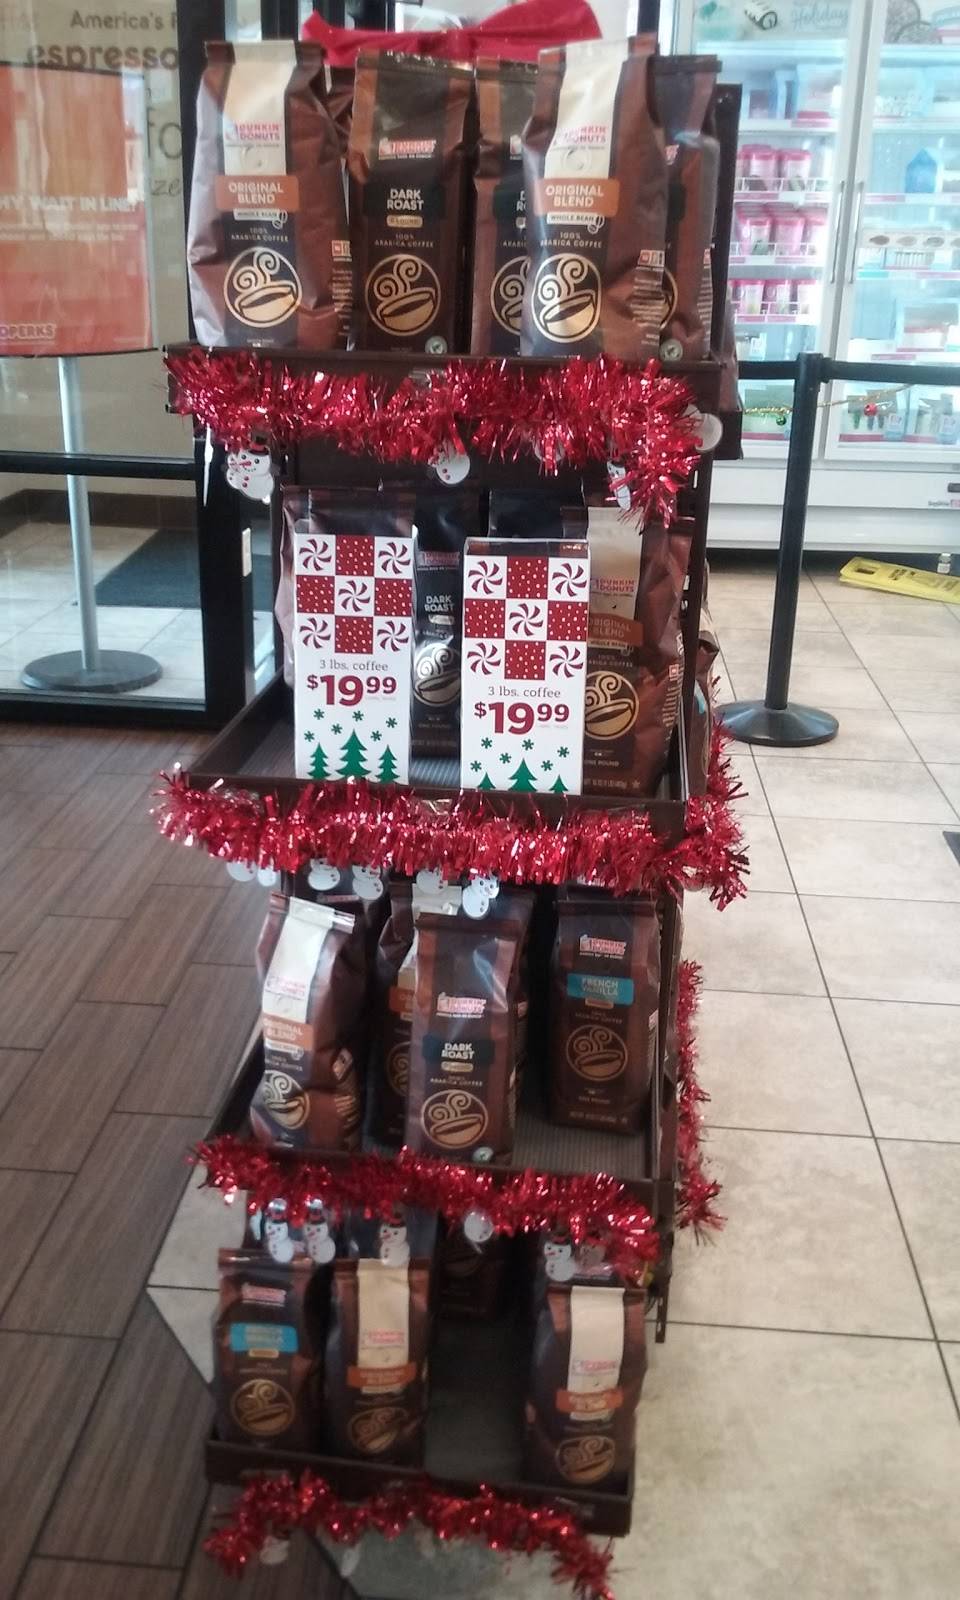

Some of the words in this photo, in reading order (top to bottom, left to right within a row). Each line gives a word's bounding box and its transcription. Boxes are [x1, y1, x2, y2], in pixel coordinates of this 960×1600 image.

[70, 10, 164, 30] America's
[27, 44, 178, 72] espresso
[228, 181, 284, 194] ORIGINAL
[545, 183, 605, 198] ORIGINAL
[237, 193, 276, 205] BLEND
[389, 188, 421, 200] DARK
[386, 199, 424, 211] ROAST
[553, 196, 595, 208] BLEND
[426, 595, 452, 604] DARK
[424, 603, 454, 612] ROAST
[319, 659, 327, 670] 3
[330, 659, 350, 671] lbs.
[352, 660, 389, 672] coffee
[488, 686, 496, 696] 3
[499, 686, 520, 697] lbs.
[523, 687, 561, 699] coffee
[444, 1042, 473, 1052] DARK
[441, 1050, 475, 1060] ROAST
